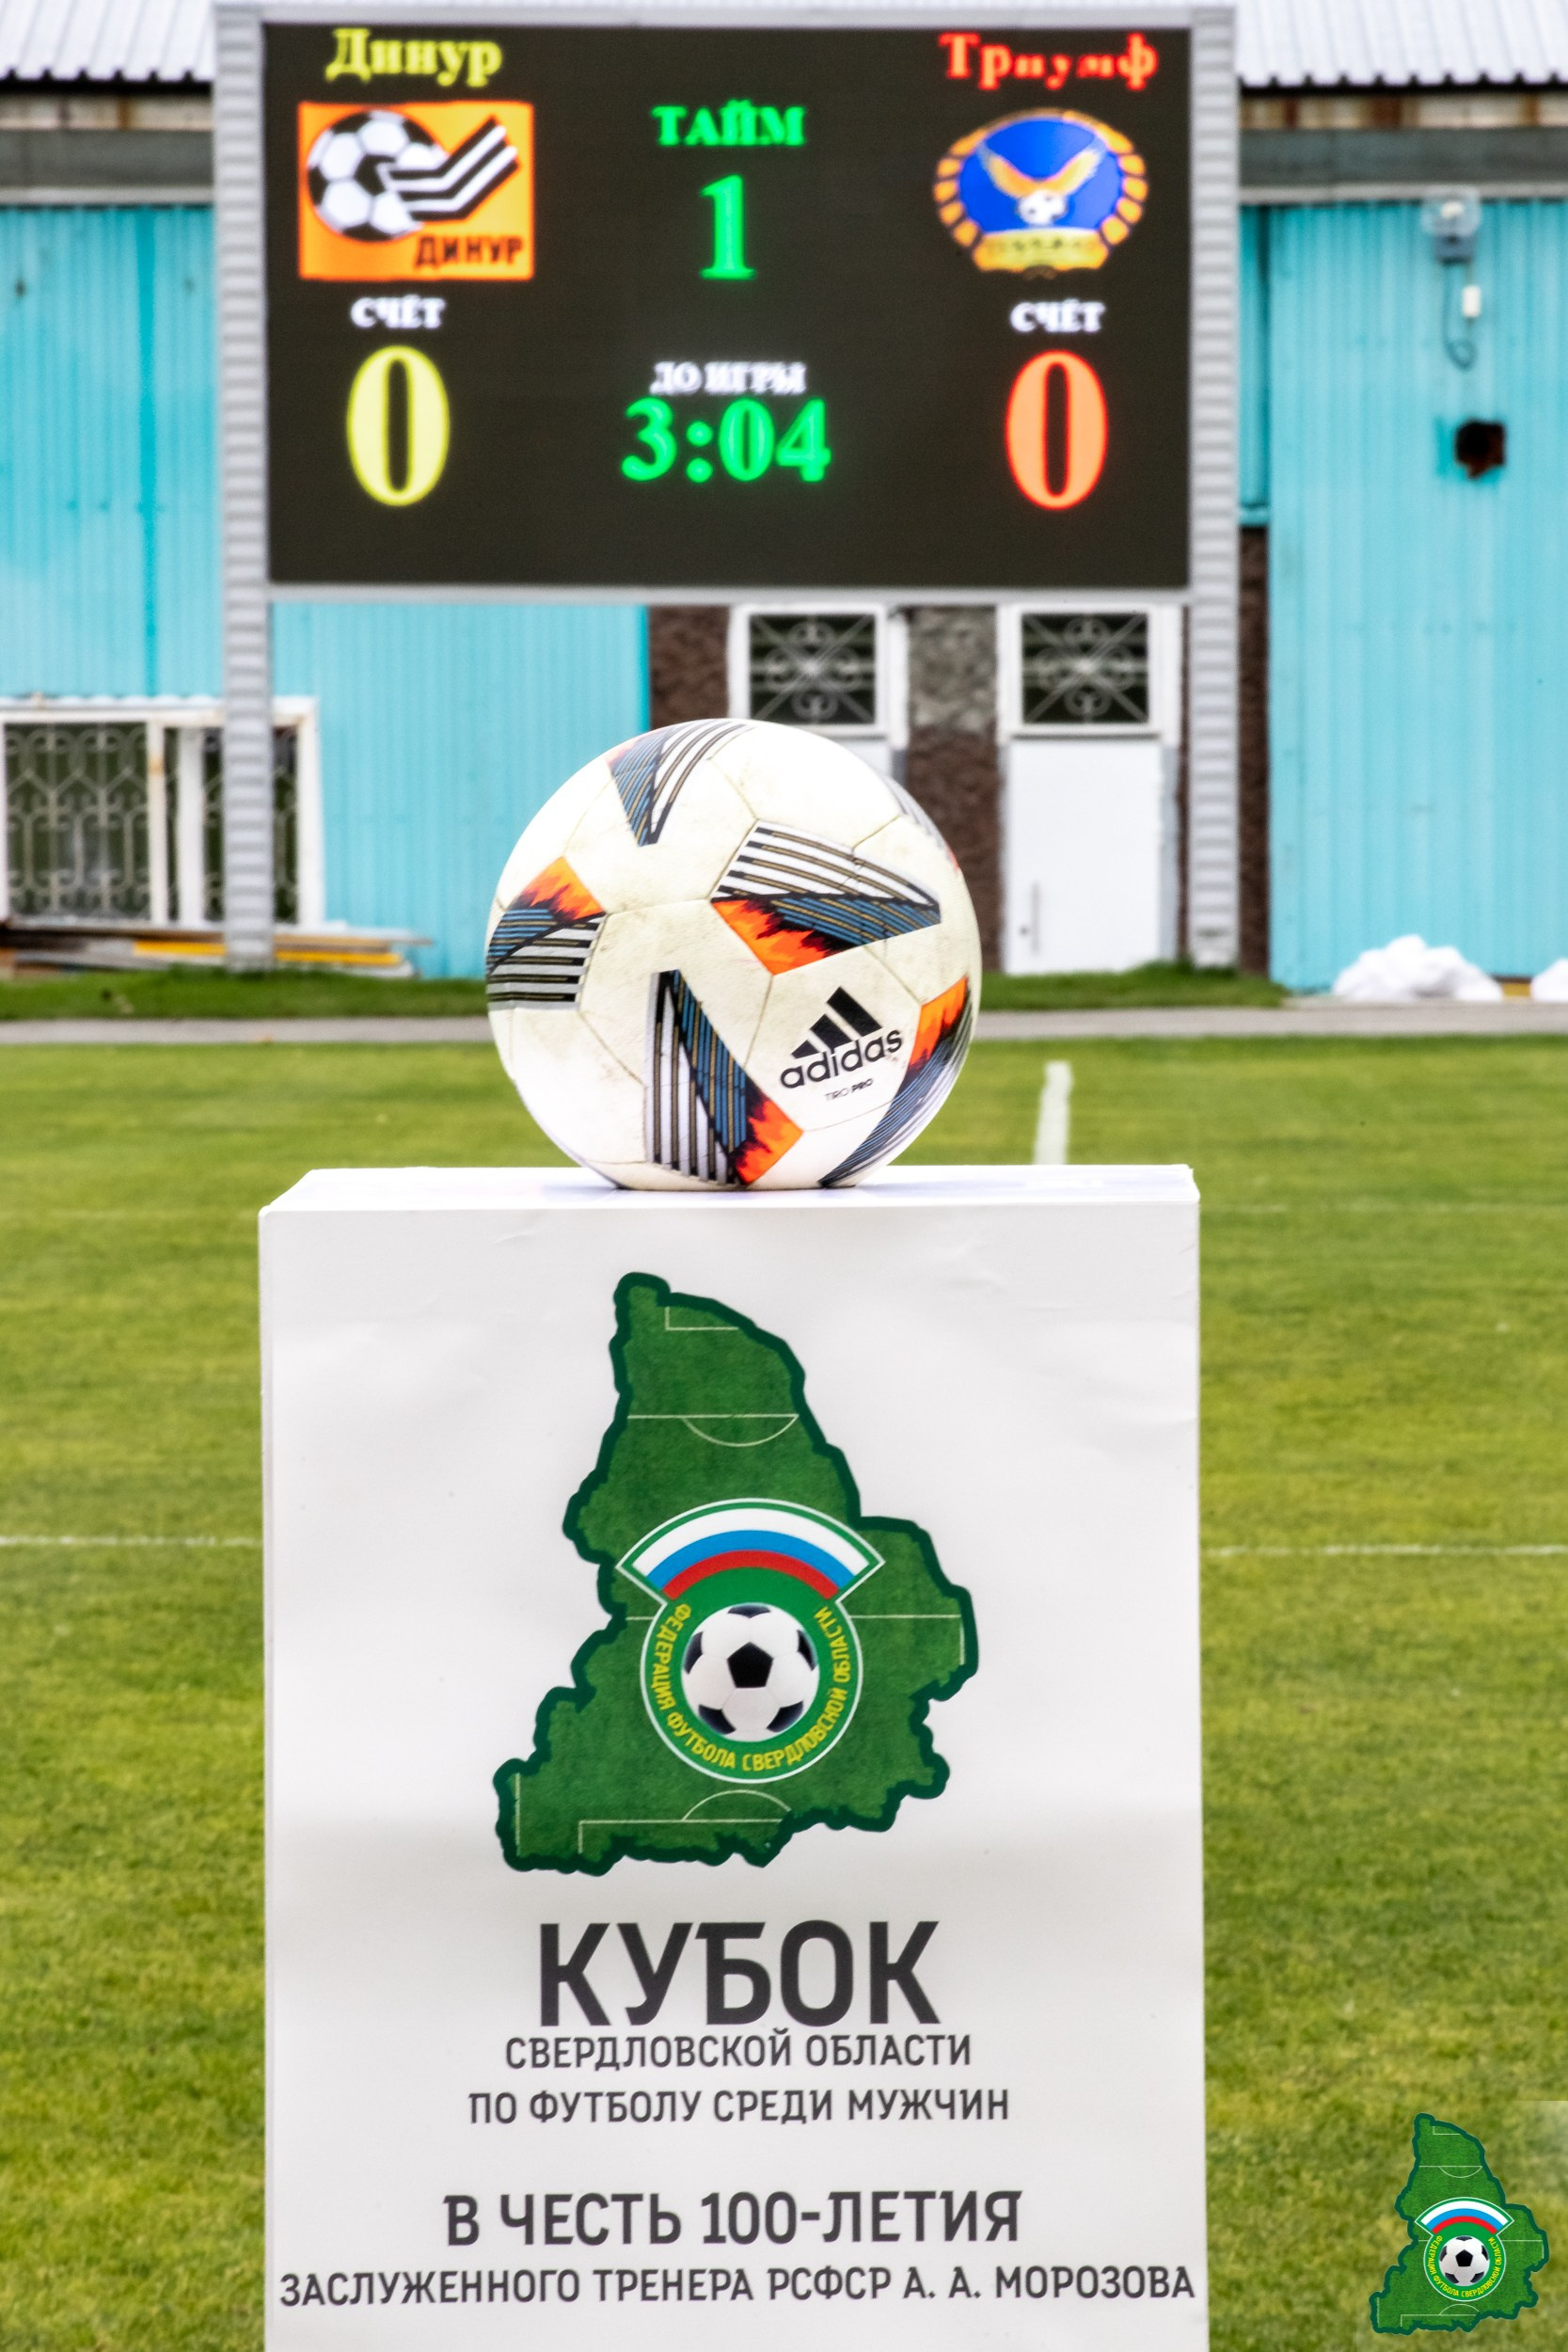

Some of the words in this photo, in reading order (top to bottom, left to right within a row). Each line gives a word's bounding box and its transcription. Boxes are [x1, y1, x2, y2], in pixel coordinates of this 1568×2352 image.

[325, 28, 502, 87] Динур
[938, 32, 1159, 90] Триумф
[652, 100, 806, 147] ТАЙМ
[414, 236, 523, 269] ДИНУР
[699, 174, 757, 280] 1
[649, 361, 703, 395] ДО
[704, 361, 807, 395] ИГРЫ
[346, 344, 450, 507] 0
[622, 396, 832, 485] 3:04
[1005, 350, 1108, 511] 0
[780, 1029, 903, 1089] adidas
[850, 1078, 874, 1093] PRO
[651, 1603, 692, 1711] ФЕДЕРАЦИЯ
[814, 1605, 851, 1683] ОБЛАСТИ
[666, 1711, 736, 1770] ФУТБОЛА
[741, 1687, 847, 1772] СВЕРДЛОВСКОЙ
[539, 1920, 941, 2026] КУБОК
[505, 2027, 791, 2071] СВЕРДЛОВСКОЙ
[806, 2034, 971, 2067] ОБЛАСТИ
[468, 2092, 517, 2123] ПО
[530, 2090, 702, 2123] ФУТБОЛУ
[713, 2090, 832, 2124] СРЕДИ
[847, 2089, 1009, 2121] МУЖЧИН
[443, 2195, 480, 2246] В
[500, 2192, 681, 2246] ЧЕСТЬ
[702, 2190, 1022, 2245] 100-ЛЕТИЯ
[280, 2269, 579, 2307] ЗАСЛУЖЕННОГО
[593, 2268, 753, 2301] ТРЕНЕРА
[767, 2265, 892, 2300] РСФСР
[903, 2266, 936, 2298] А.
[948, 2266, 981, 2298] А.
[995, 2265, 1195, 2299] МОРОЗОВА
